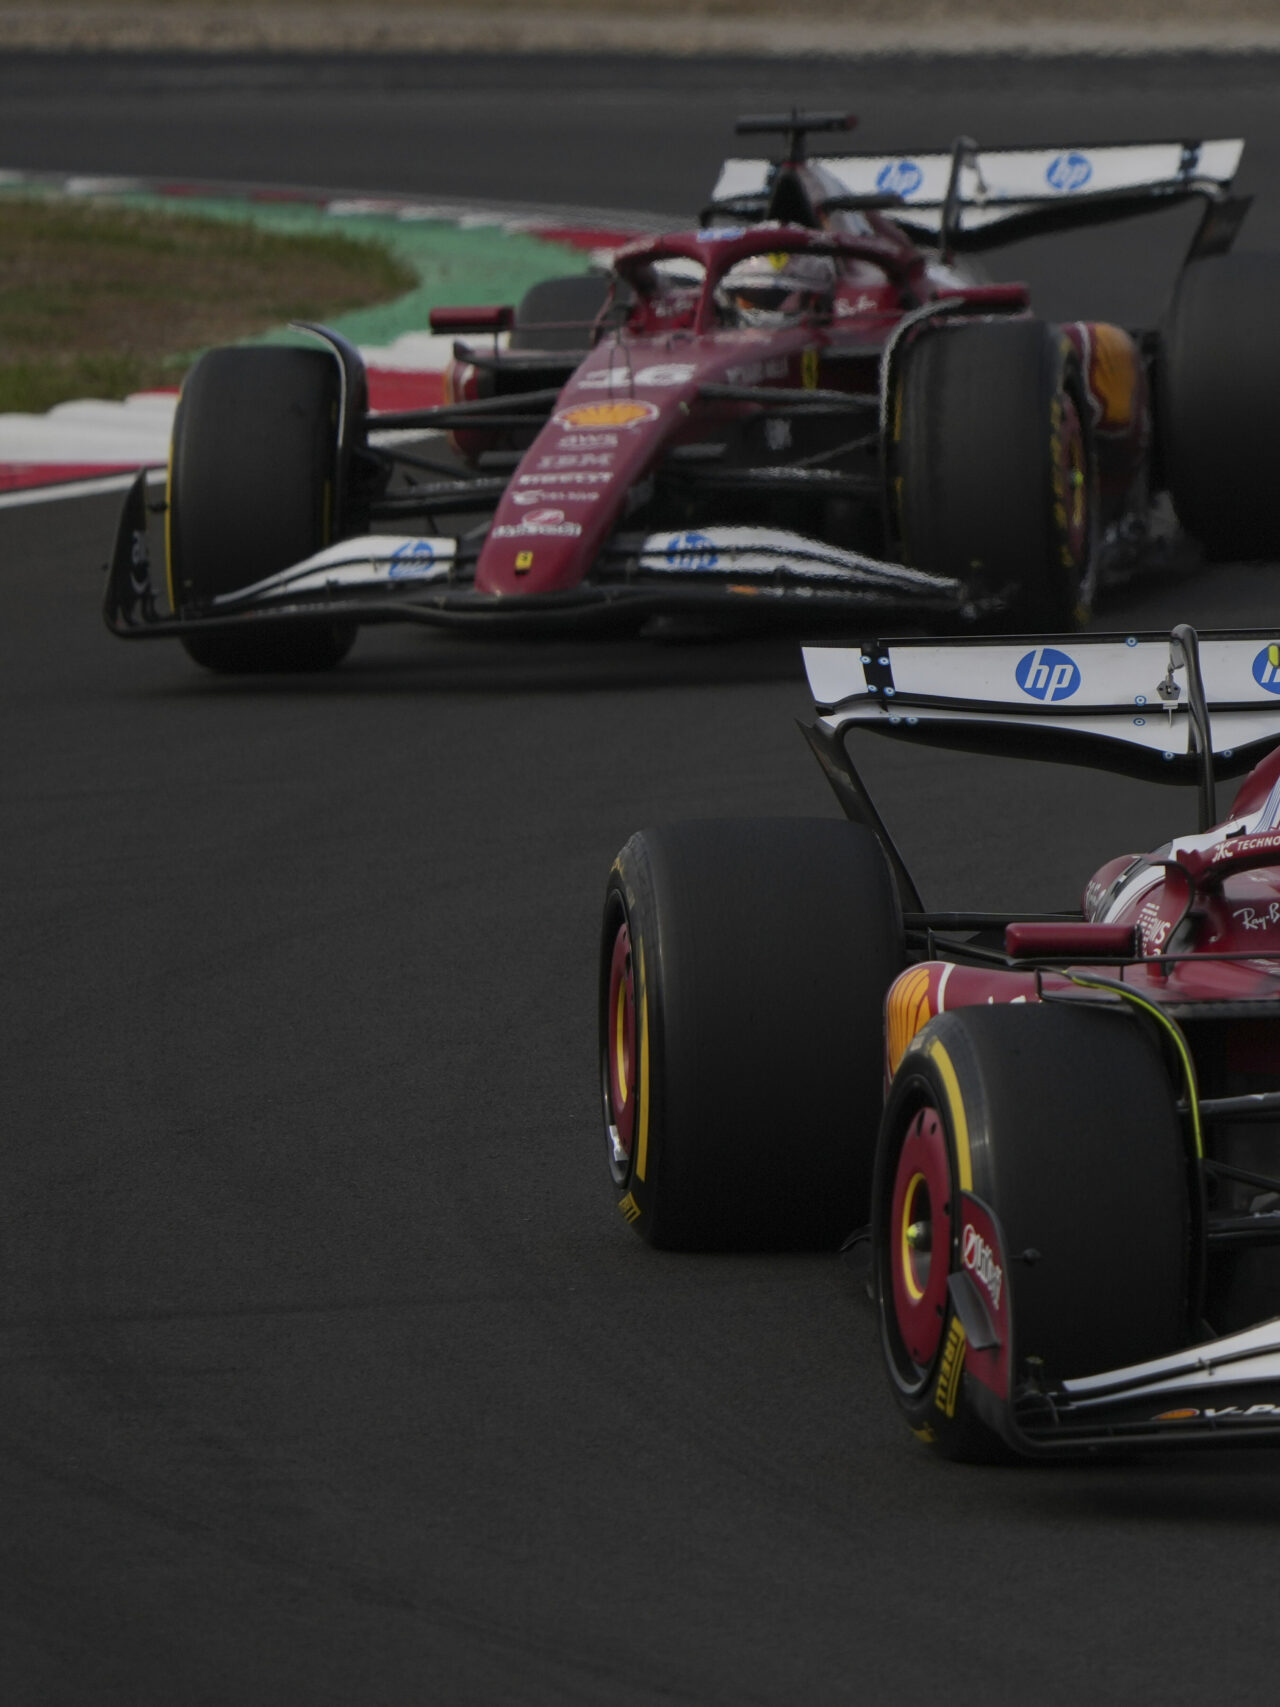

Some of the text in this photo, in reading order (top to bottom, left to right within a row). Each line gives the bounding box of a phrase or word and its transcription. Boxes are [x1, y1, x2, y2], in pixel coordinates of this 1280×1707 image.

[1049, 153, 1090, 190] hp
[576, 362, 698, 389] 16
[1021, 648, 1075, 701] hp
